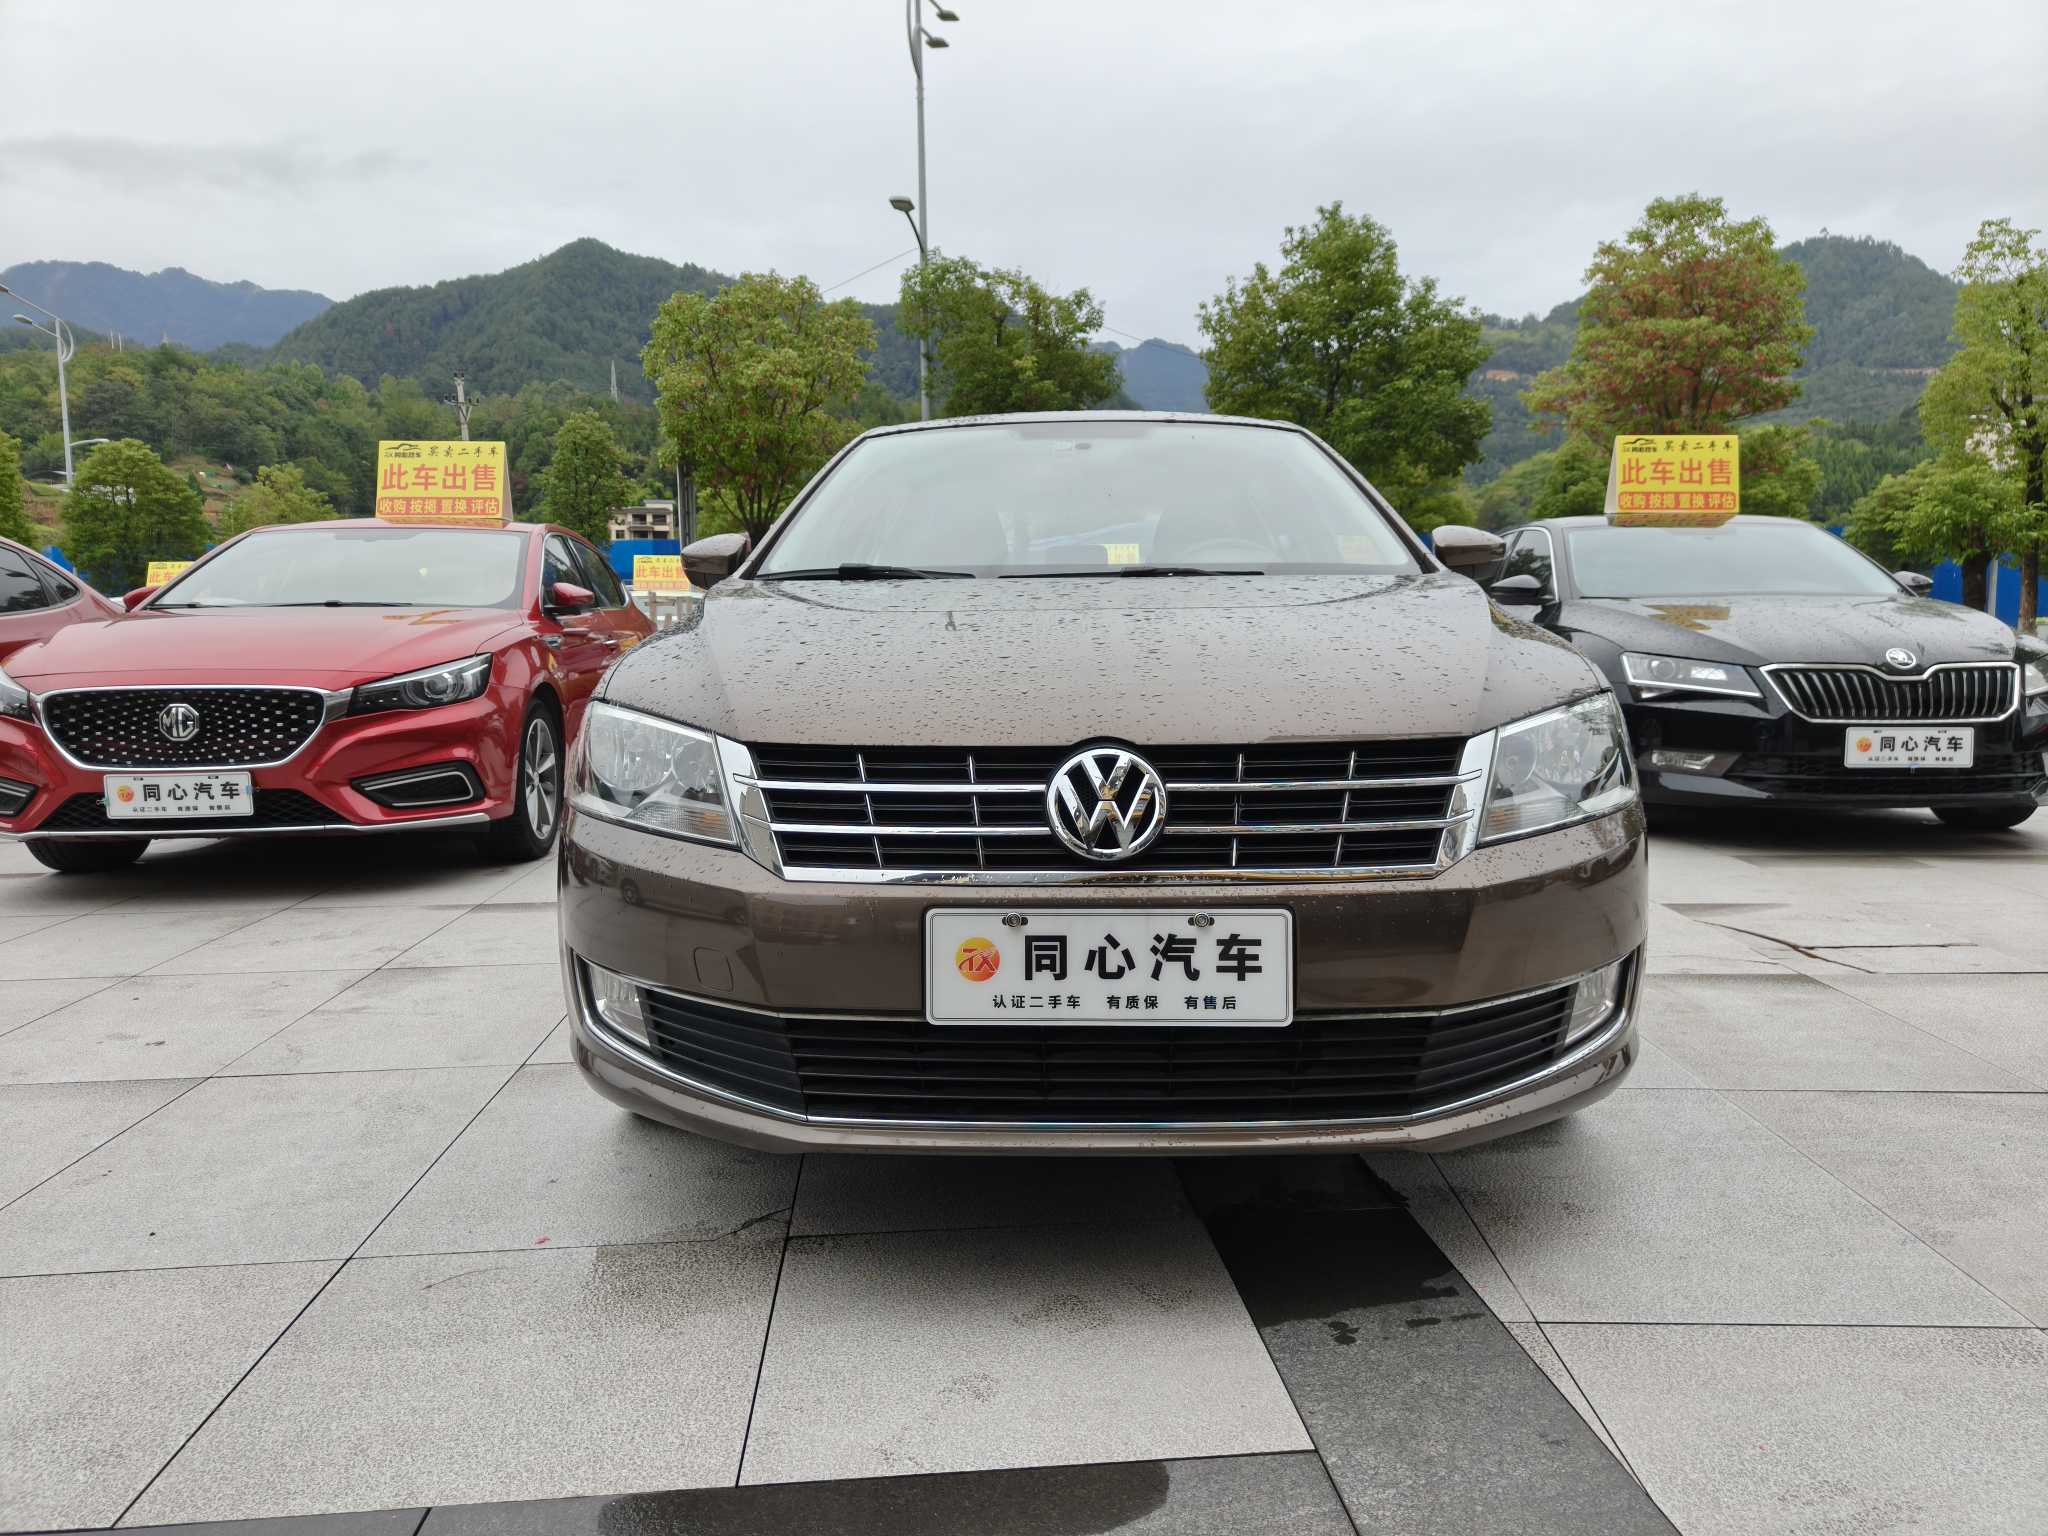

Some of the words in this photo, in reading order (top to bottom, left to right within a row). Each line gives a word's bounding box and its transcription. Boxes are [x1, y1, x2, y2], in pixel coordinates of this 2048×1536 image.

[381, 463, 497, 491] 此车出售
[1620, 457, 1732, 486] 此车出售
[162, 707, 195, 737] MG
[1880, 736, 1963, 752] 同心汽车
[143, 781, 240, 801] 同心汽车
[1024, 933, 1263, 982] 同心汽车
[992, 995, 1081, 1010] 认证二手车
[1107, 995, 1159, 1010] 有质保
[1184, 995, 1237, 1010] 有售后
